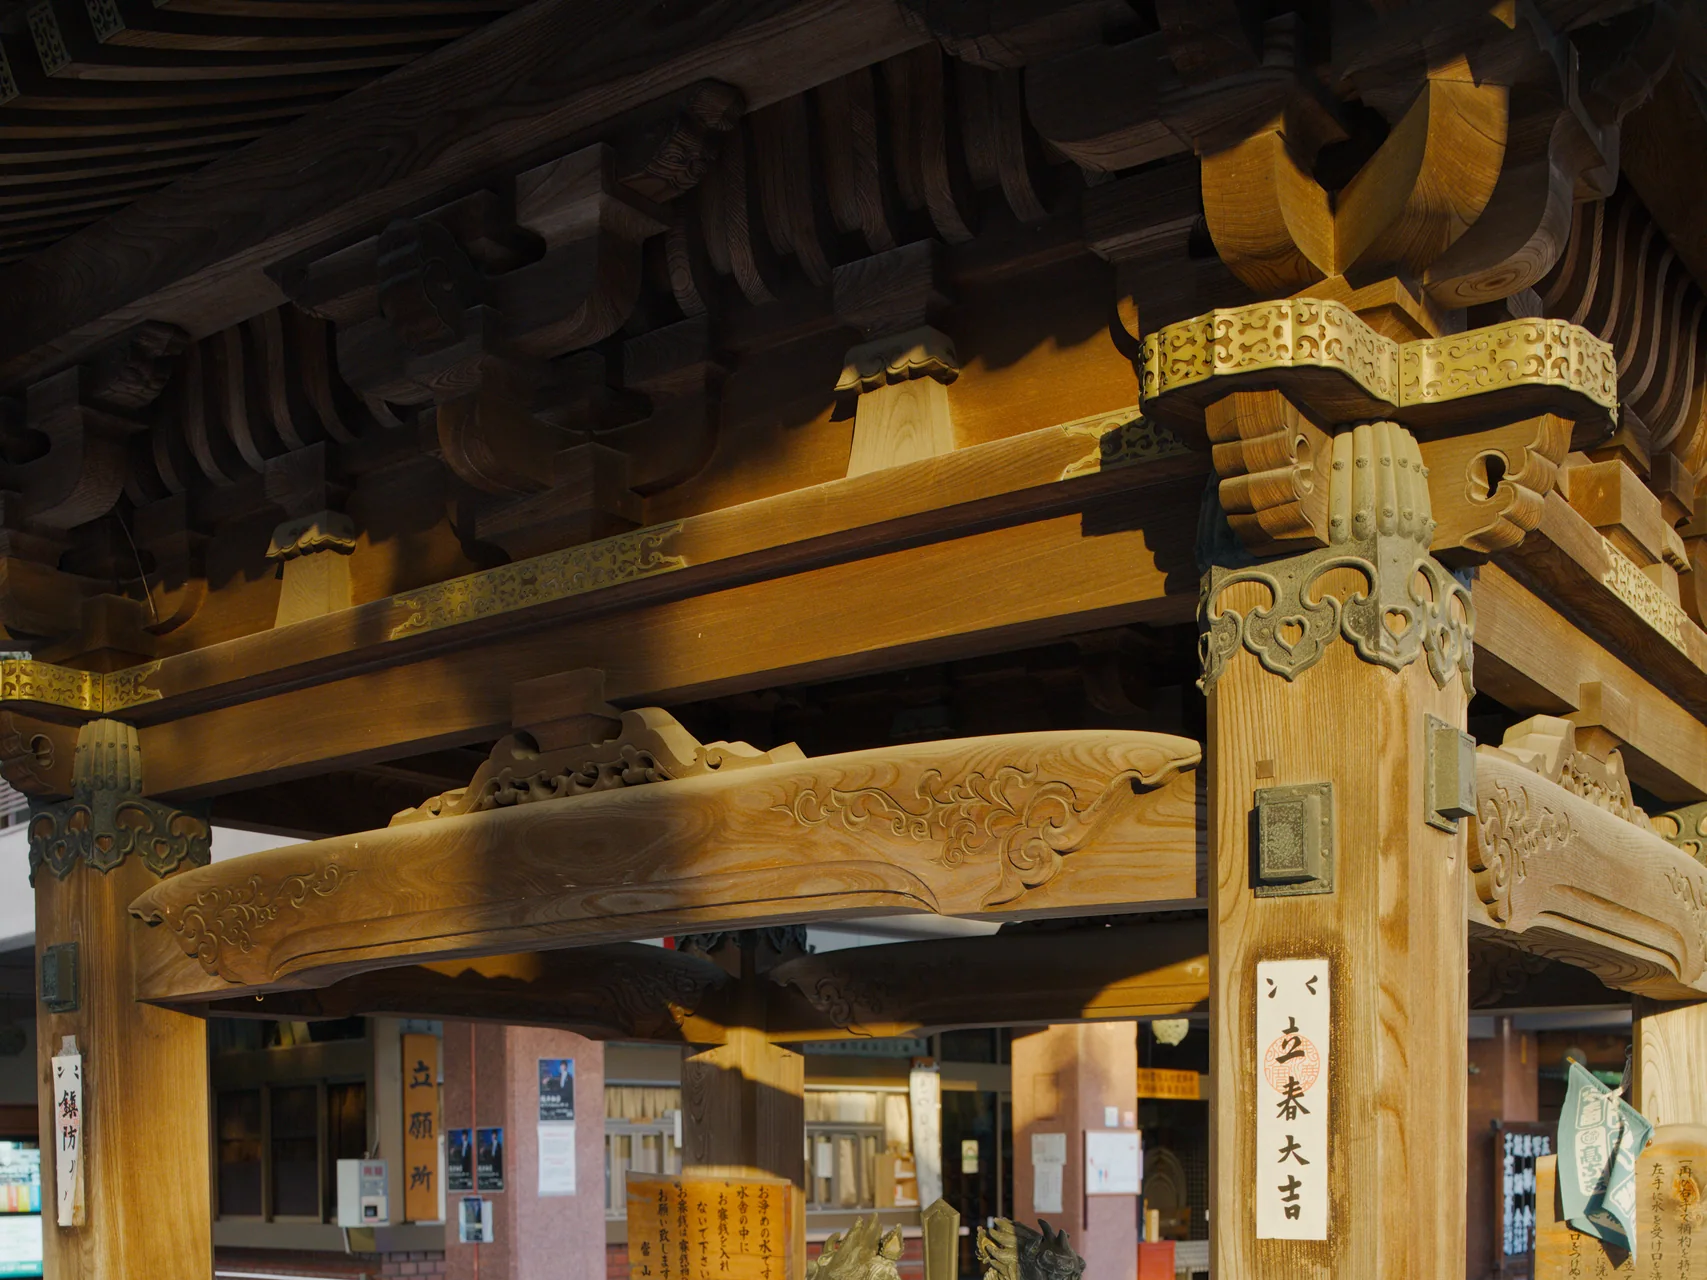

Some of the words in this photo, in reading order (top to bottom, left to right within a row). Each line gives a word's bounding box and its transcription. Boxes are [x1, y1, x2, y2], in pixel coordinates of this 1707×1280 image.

[409, 1060, 433, 1192] 立願所
[1275, 1016, 1311, 1220] 立春大吉
